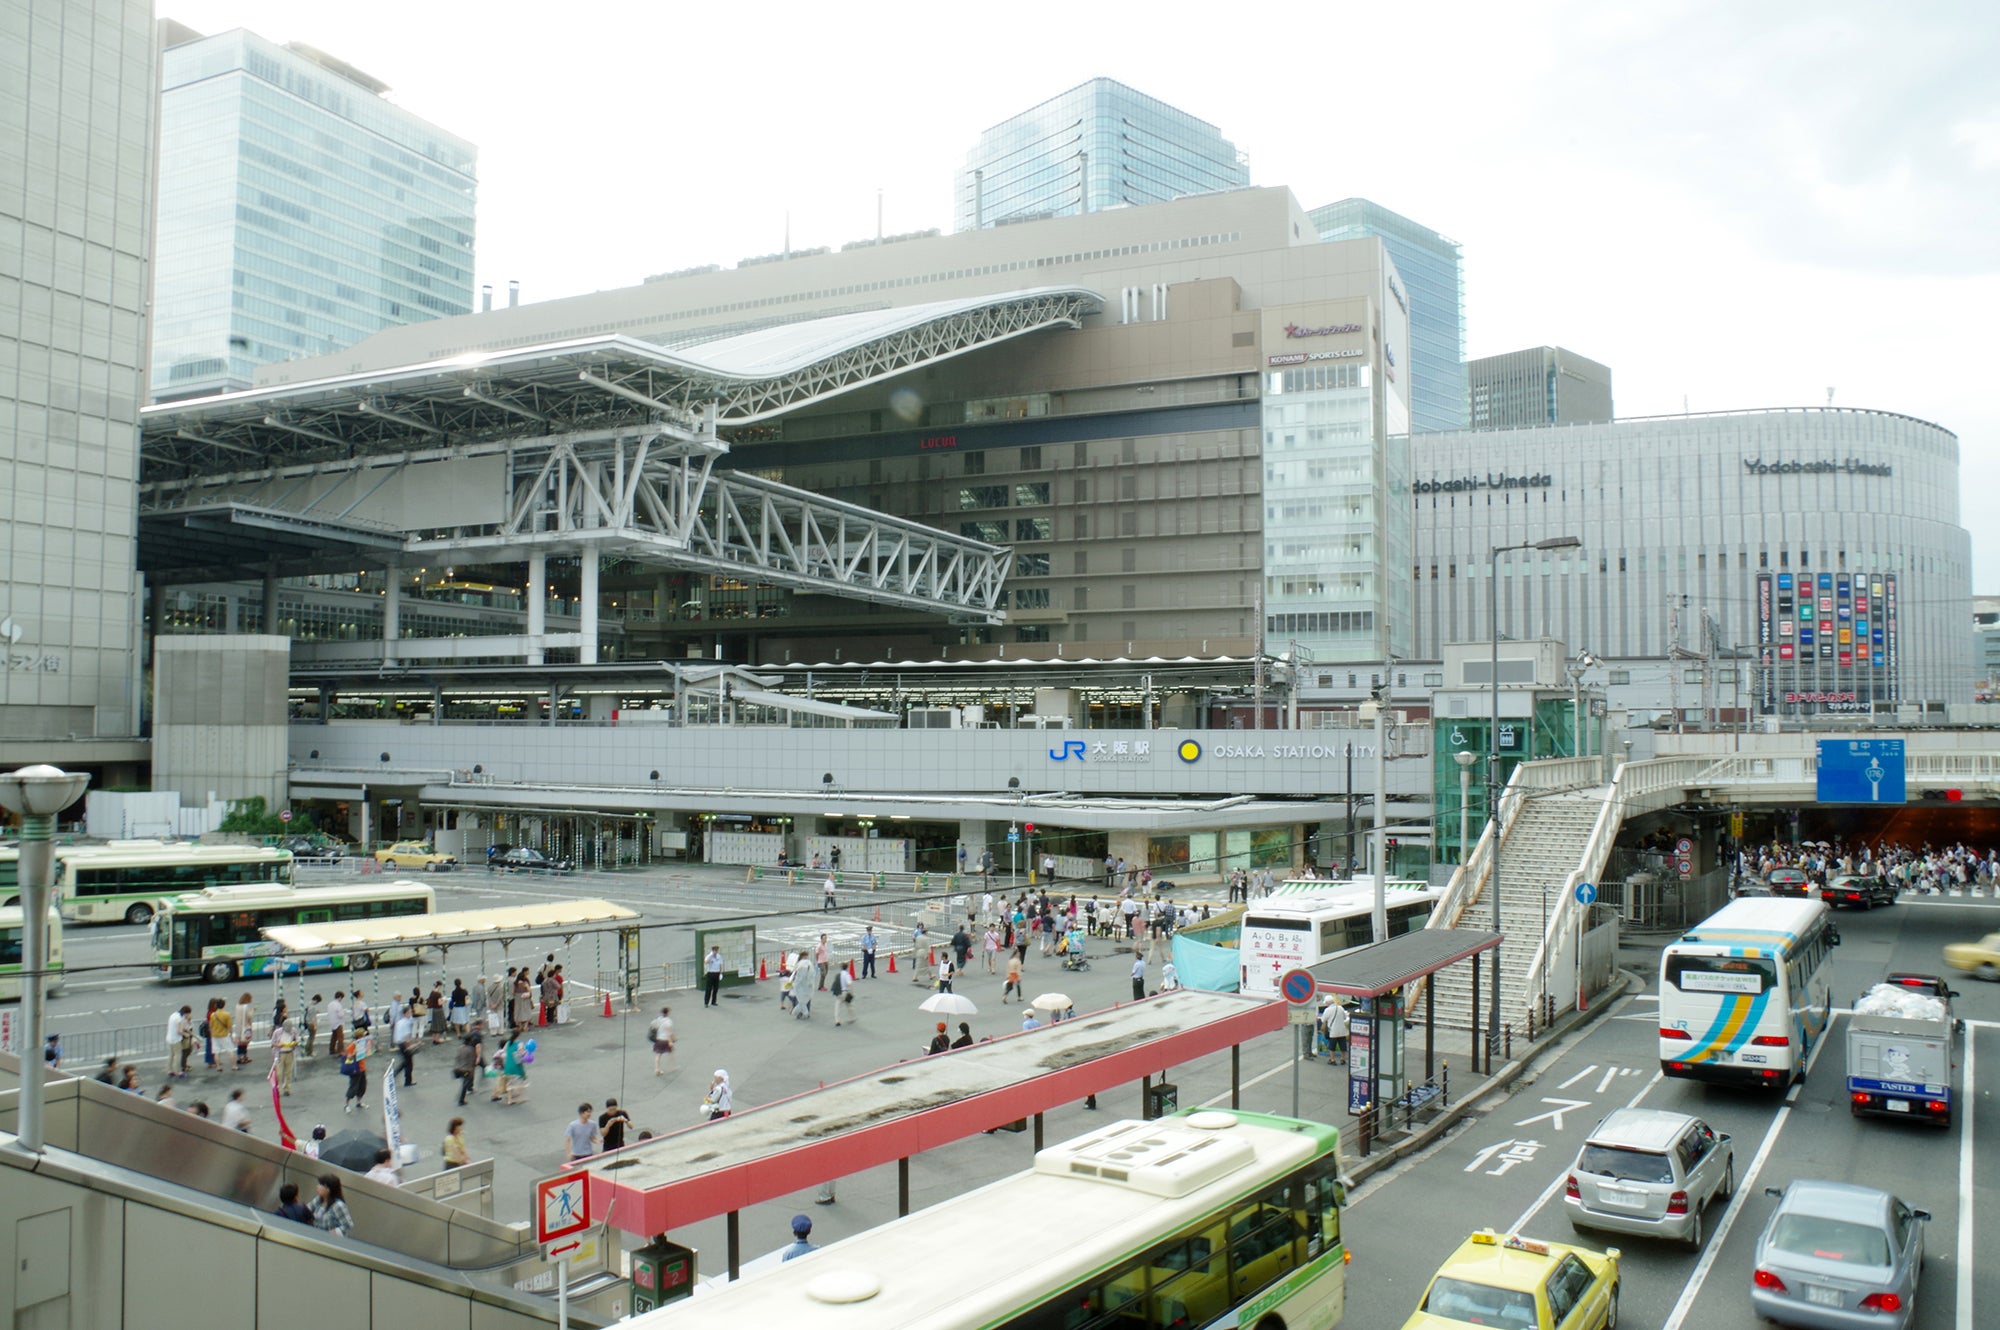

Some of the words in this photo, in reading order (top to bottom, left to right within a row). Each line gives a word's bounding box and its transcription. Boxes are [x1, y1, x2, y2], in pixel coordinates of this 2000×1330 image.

[1271, 355, 1303, 364] KONAMI
[1309, 351, 1339, 361] SPORTS
[1341, 349, 1363, 358] CLUB
[1744, 458, 1892, 477] Yodobashi-Umeda
[0, 654, 61, 673] ラン街
[1785, 692, 1857, 703] ヨドバシカメラ
[1050, 740, 1087, 761] JR
[1092, 740, 1150, 755] 大阪駅
[1214, 745, 1265, 759] OSAKA
[1273, 745, 1336, 759] STATION
[1878, 741, 1900, 751] 十三
[1671, 1020, 1689, 1030] JR
[1880, 1082, 1916, 1092] TASTER
[642, 1272, 649, 1286] 2
[672, 1272, 679, 1285] 2
